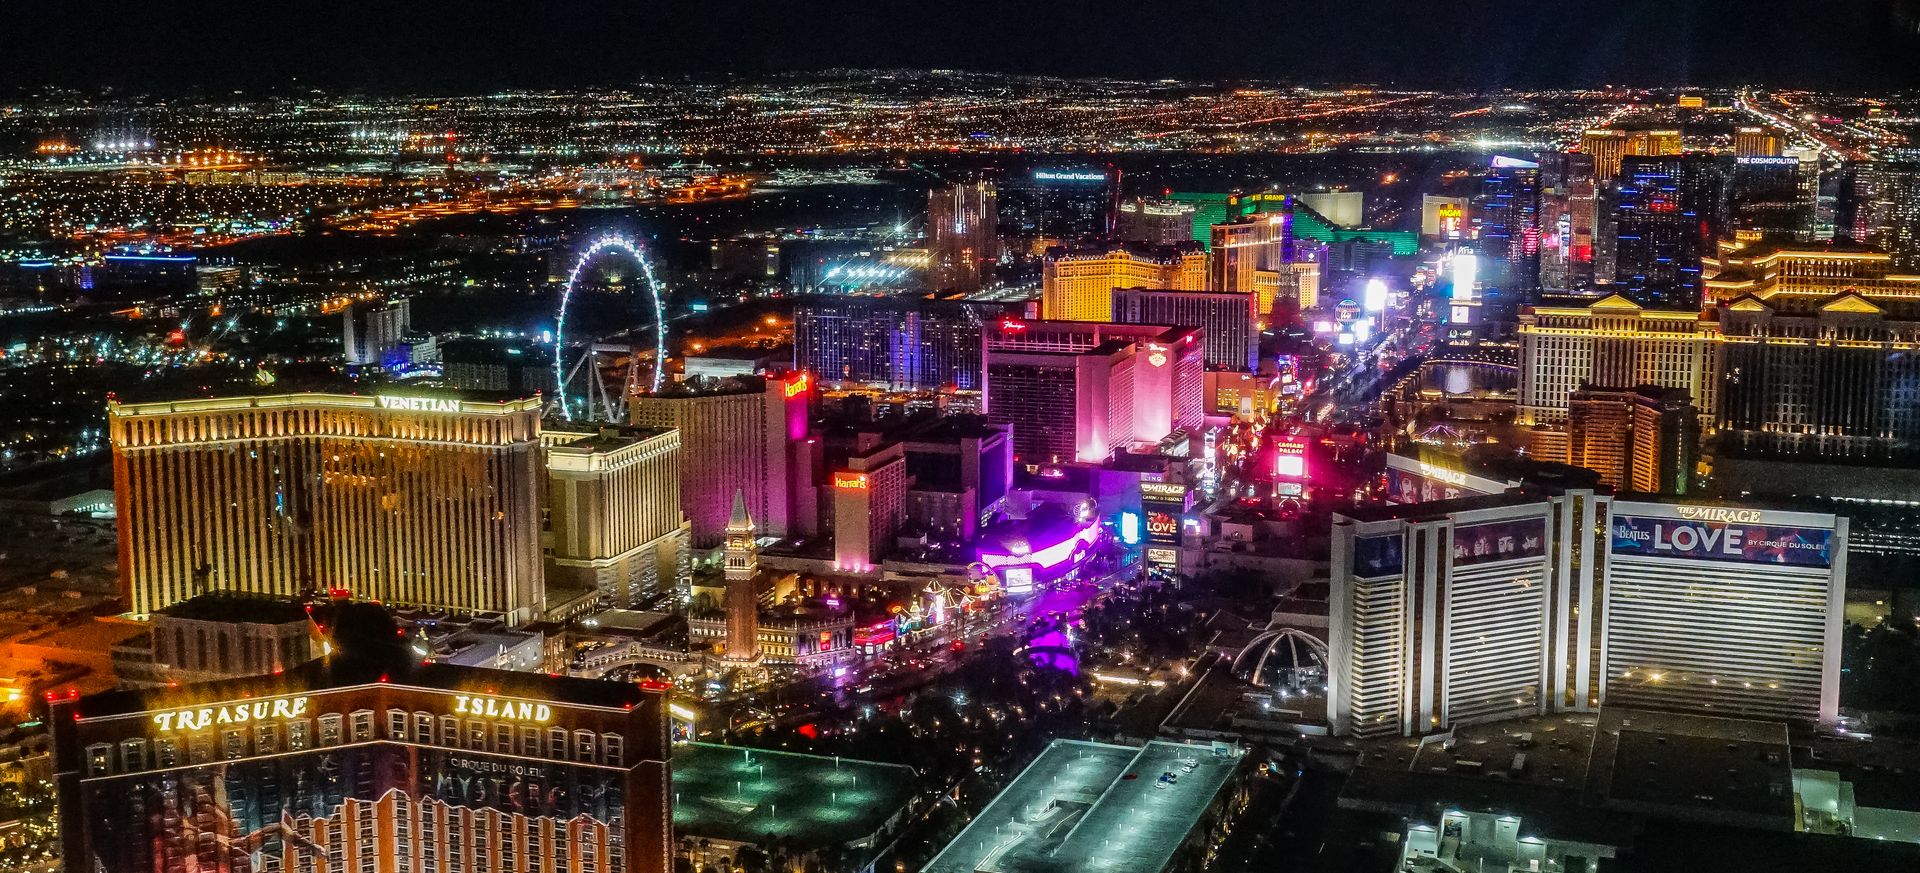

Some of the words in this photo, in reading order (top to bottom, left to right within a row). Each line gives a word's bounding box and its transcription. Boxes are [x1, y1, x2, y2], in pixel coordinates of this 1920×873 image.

[1751, 157, 1799, 165] COSMOPOLITAN
[1440, 209, 1461, 217] MGM
[380, 395, 460, 412] VENETIAN
[1144, 485, 1184, 494] MIRAGE
[1683, 508, 1760, 522] MIRAGE
[1147, 522, 1177, 533] LOVE
[1654, 524, 1742, 554] LOVE
[1759, 540, 1787, 548] CIRQUE
[153, 697, 308, 731] TREASURE
[455, 696, 550, 721] ISLAND
[451, 758, 490, 773] CIRQUE
[492, 762, 507, 773] DU
[510, 765, 545, 778] SOLEIL
